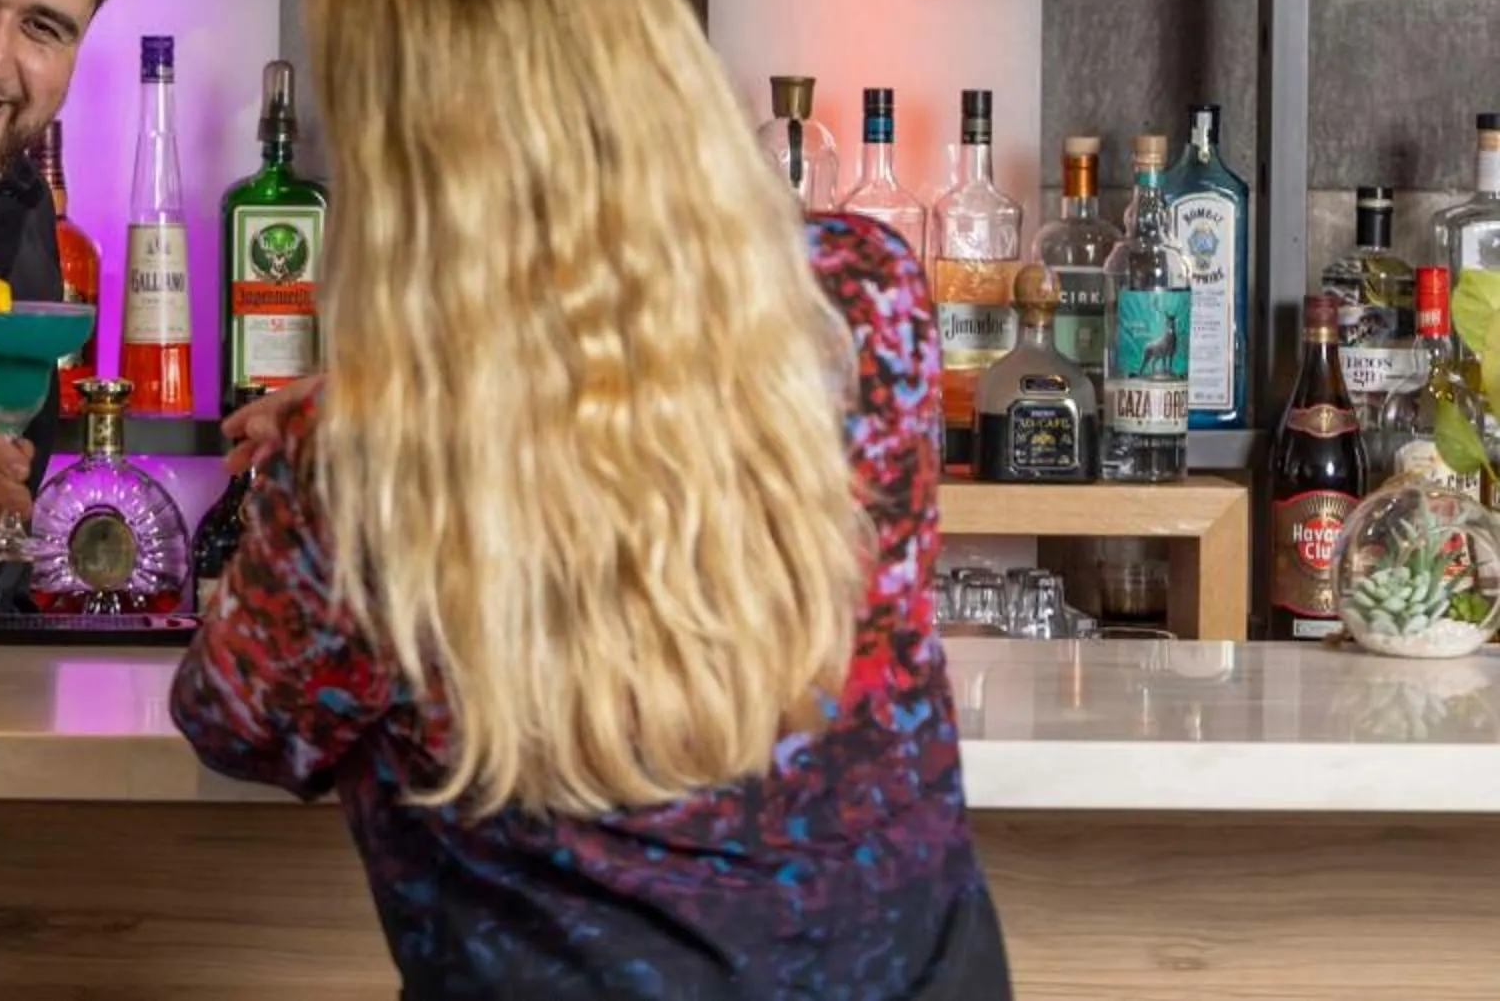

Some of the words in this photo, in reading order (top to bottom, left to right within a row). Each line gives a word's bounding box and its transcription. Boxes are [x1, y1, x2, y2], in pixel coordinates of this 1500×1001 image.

[1059, 290, 1105, 304] CIRK
[1116, 388, 1188, 418] CAZAORE
[1292, 521, 1342, 544] Hava
[1304, 540, 1336, 563] Clu
